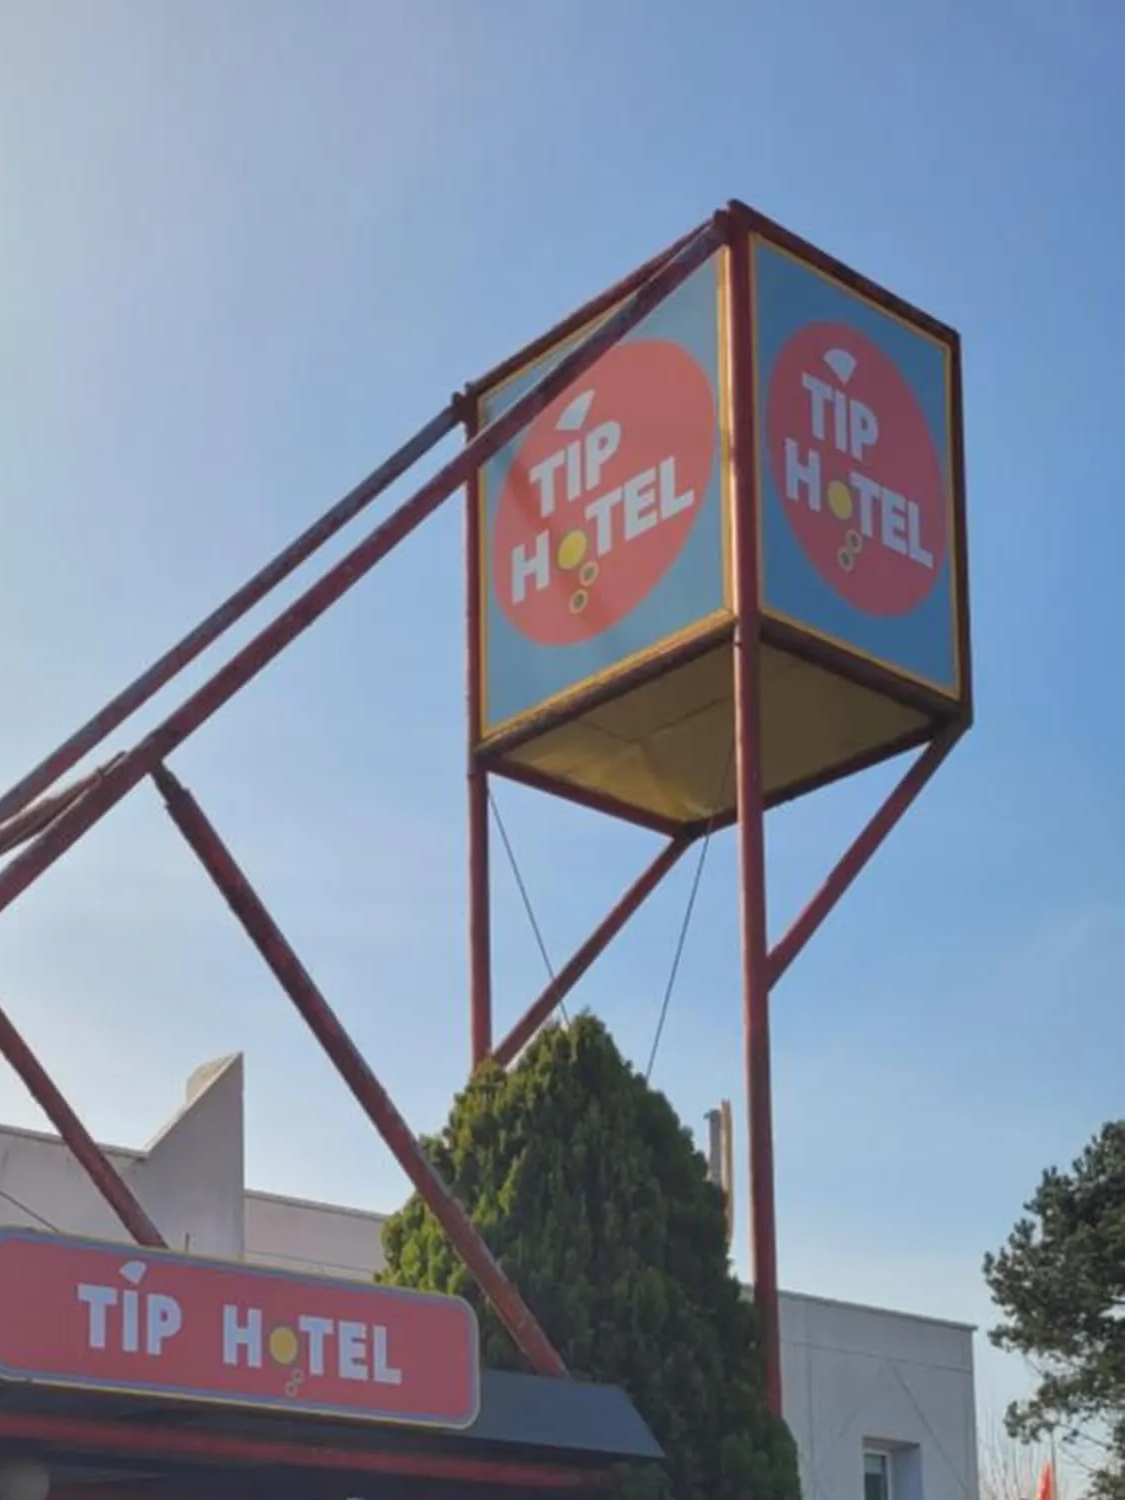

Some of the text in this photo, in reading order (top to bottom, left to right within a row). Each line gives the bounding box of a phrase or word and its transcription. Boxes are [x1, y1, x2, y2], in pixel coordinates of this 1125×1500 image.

[801, 371, 880, 462] TIP
[529, 420, 621, 517] TIP
[784, 437, 934, 570] HOTEL
[511, 456, 696, 606] HOTEL
[77, 1283, 403, 1384] TIP HOTEL
